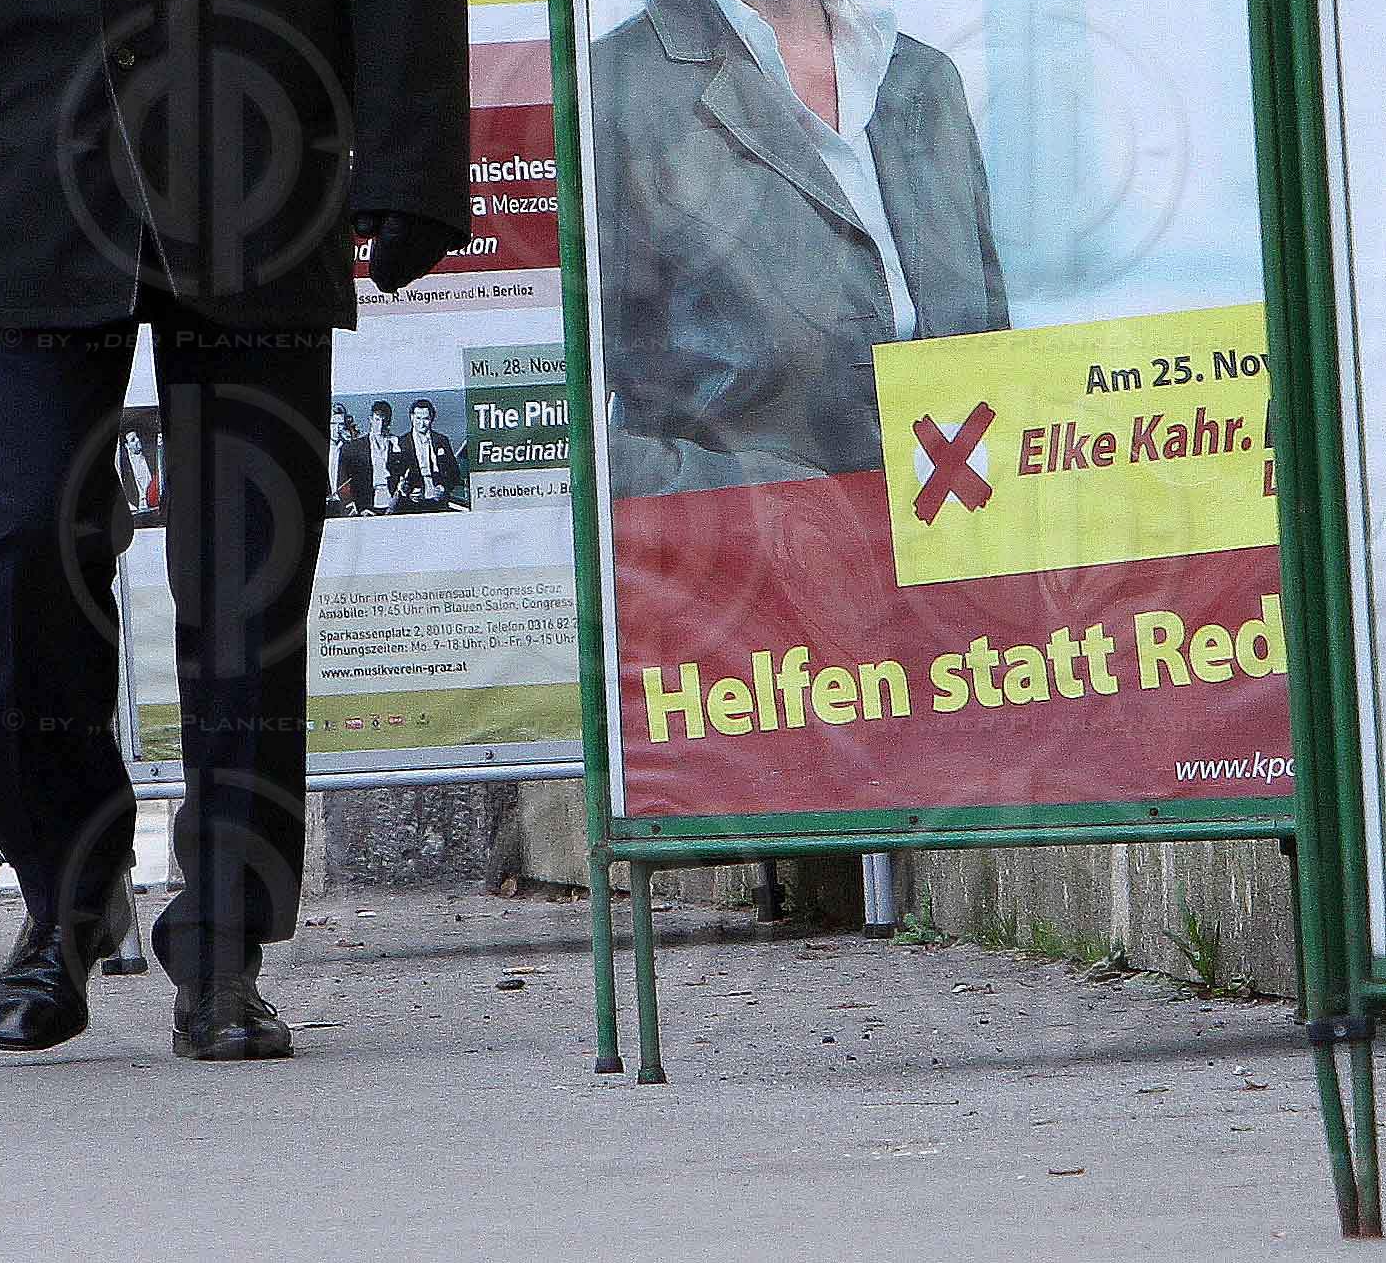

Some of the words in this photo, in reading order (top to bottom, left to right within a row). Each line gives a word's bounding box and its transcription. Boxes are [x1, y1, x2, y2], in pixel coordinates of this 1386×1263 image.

[493, 195, 558, 215] Mezzos
[407, 287, 451, 304] Wagner
[453, 287, 475, 301] und
[478, 288, 490, 299] H.
[492, 285, 534, 298] Berlioz
[503, 359, 526, 375] 28.
[1085, 364, 1142, 395] Am
[1152, 356, 1204, 387] 25.
[474, 403, 519, 430] The
[1017, 421, 1116, 476] Elke
[1129, 406, 1252, 464] Kahr.
[403, 603, 425, 615] Uhr
[426, 603, 441, 614] im
[320, 660, 468, 679] www.musikverein-graz.at
[641, 644, 912, 744] Helfen
[928, 621, 1119, 713] statt
[1132, 592, 1289, 690] Red
